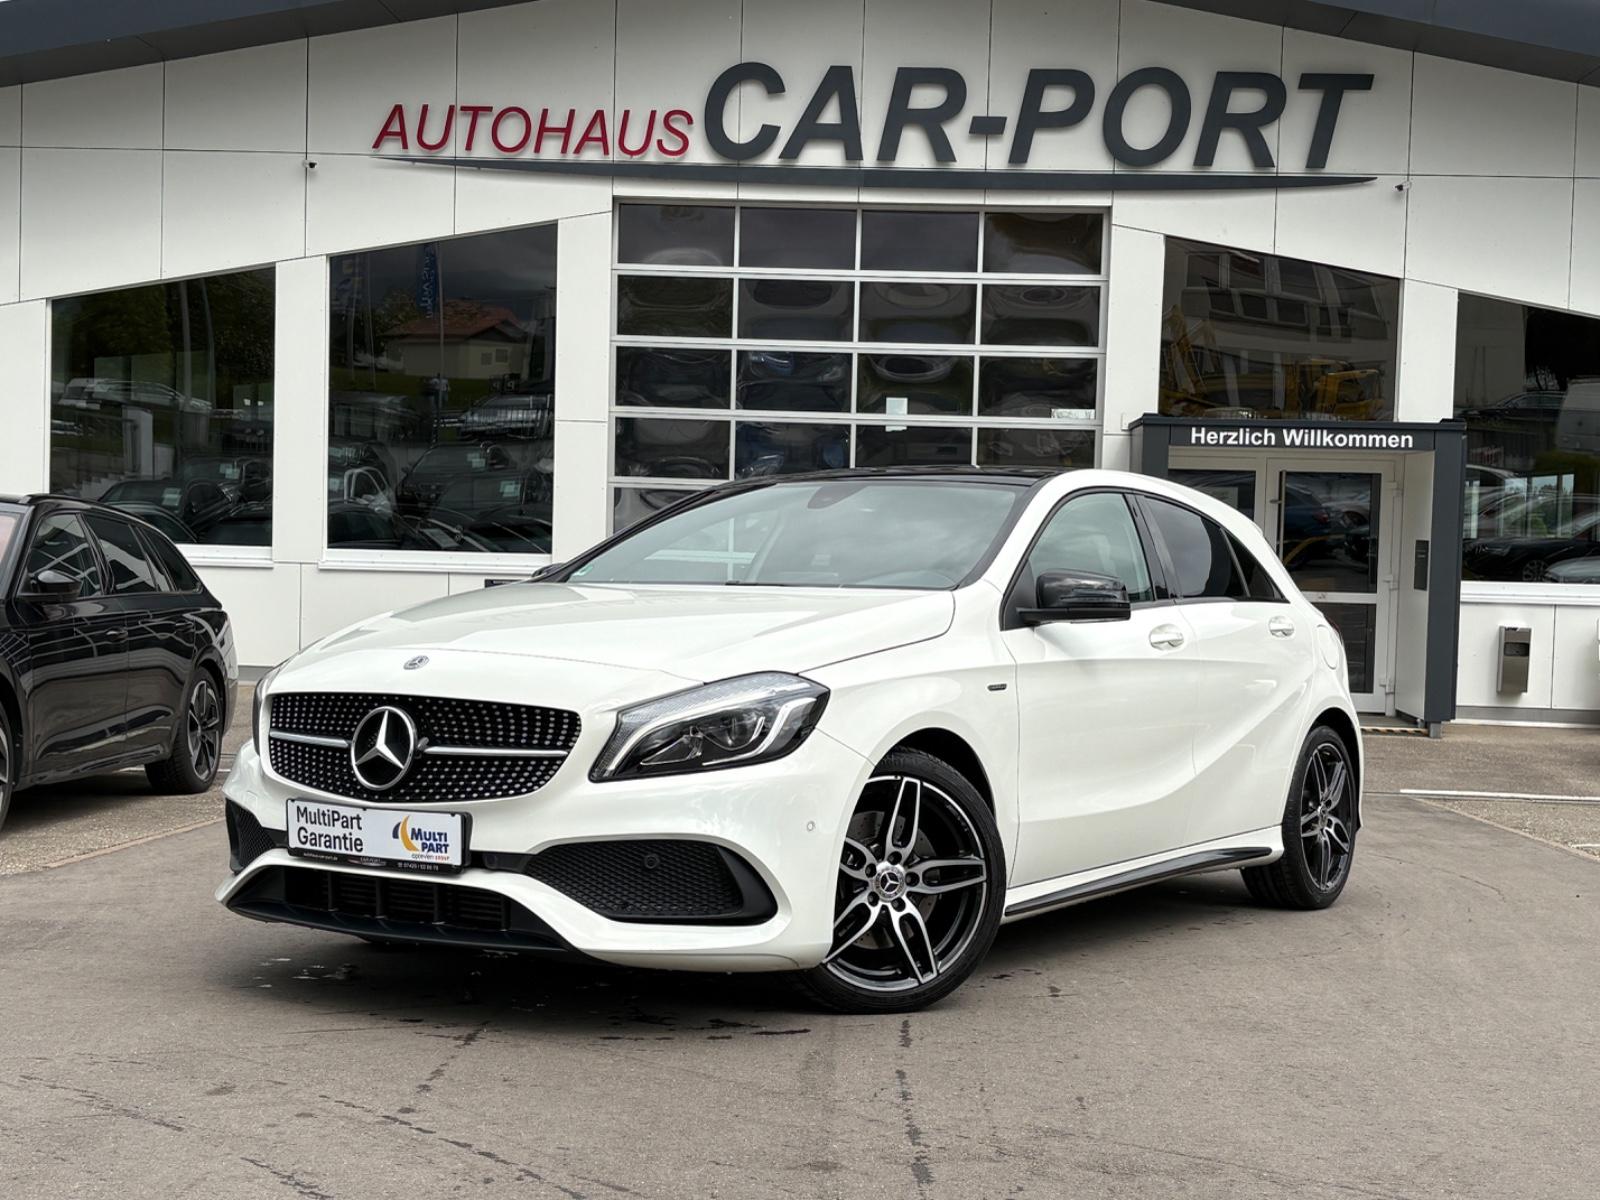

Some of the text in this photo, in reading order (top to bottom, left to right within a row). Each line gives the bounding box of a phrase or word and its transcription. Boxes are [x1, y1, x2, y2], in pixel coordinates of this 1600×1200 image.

[371, 61, 1375, 169] AUTOHAUS CAR-PORT
[1190, 427, 1414, 448] Herzlich Willkommen
[296, 805, 362, 830] MultiPart
[297, 826, 364, 853] Garantie
[410, 827, 448, 842] MULTI
[421, 841, 450, 854] PART
